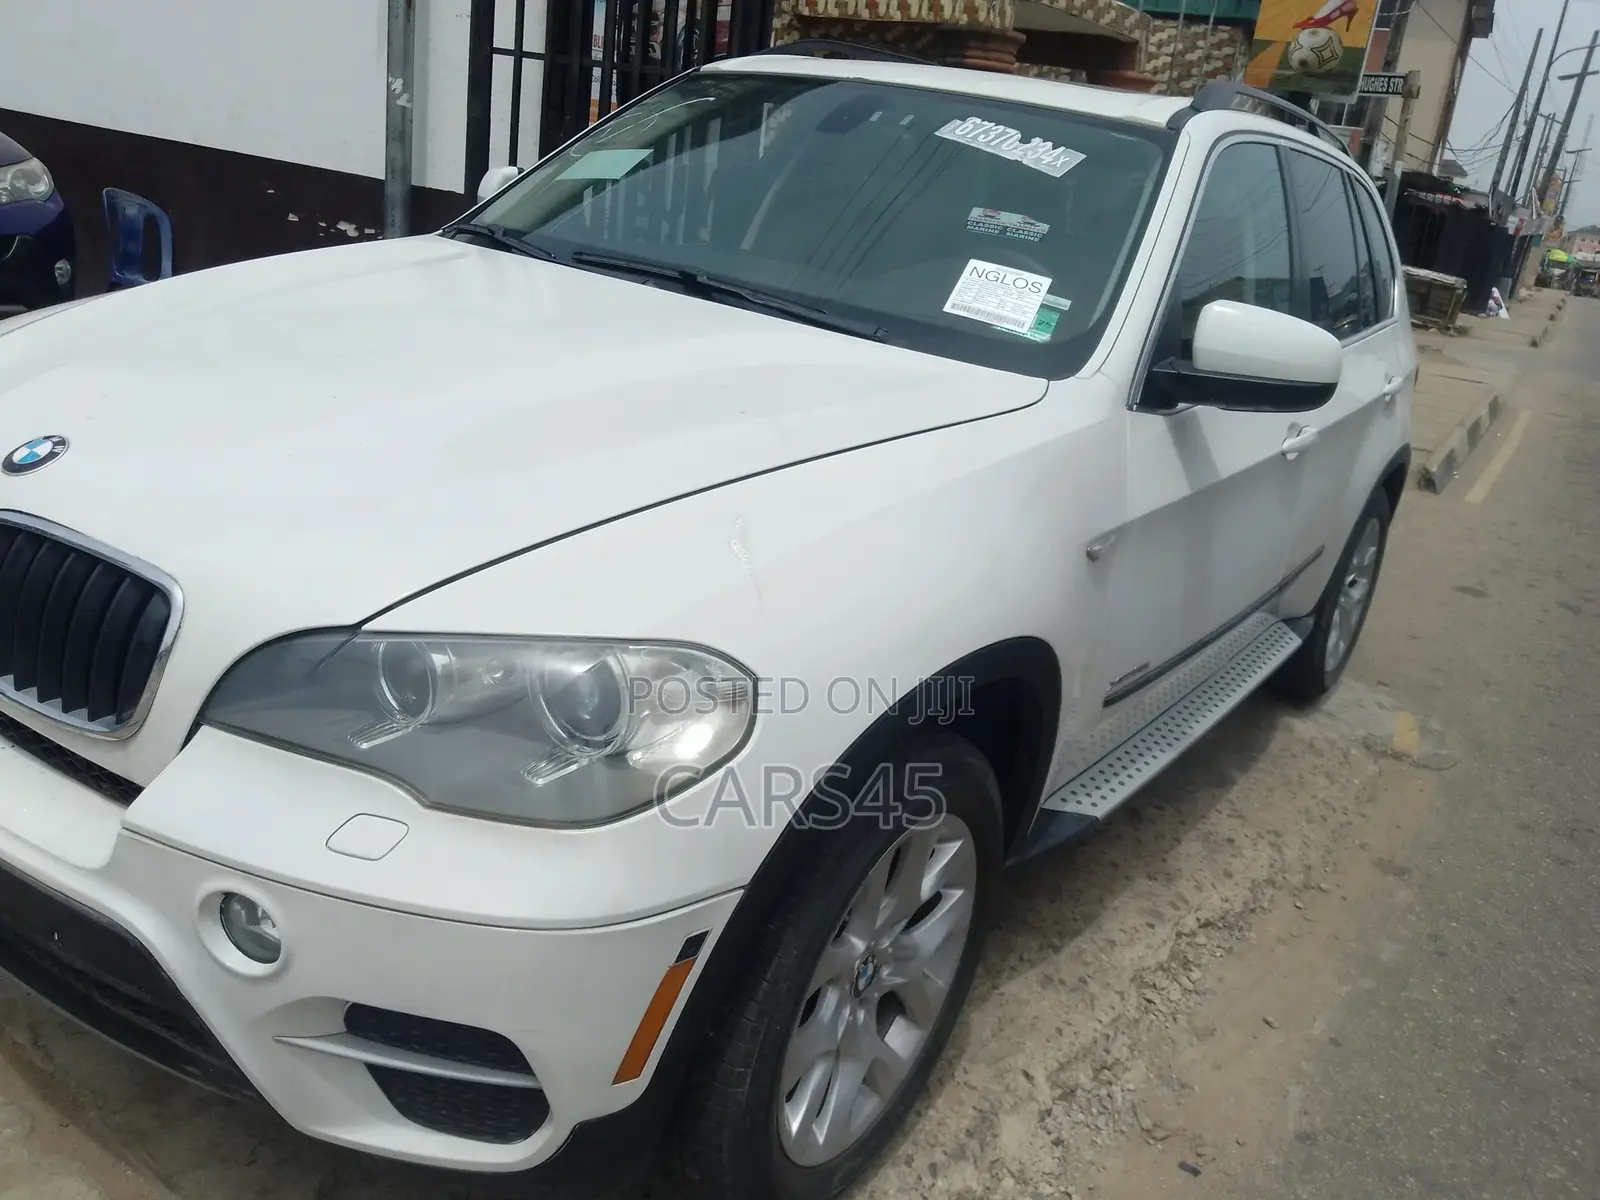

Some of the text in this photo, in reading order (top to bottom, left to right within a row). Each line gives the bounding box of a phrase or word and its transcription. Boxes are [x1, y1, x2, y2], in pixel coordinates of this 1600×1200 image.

[966, 225, 1040, 243] MARINE MARINE
[967, 220, 1043, 239] CLASSIC CLASSIC
[969, 266, 1043, 294] NGLOS
